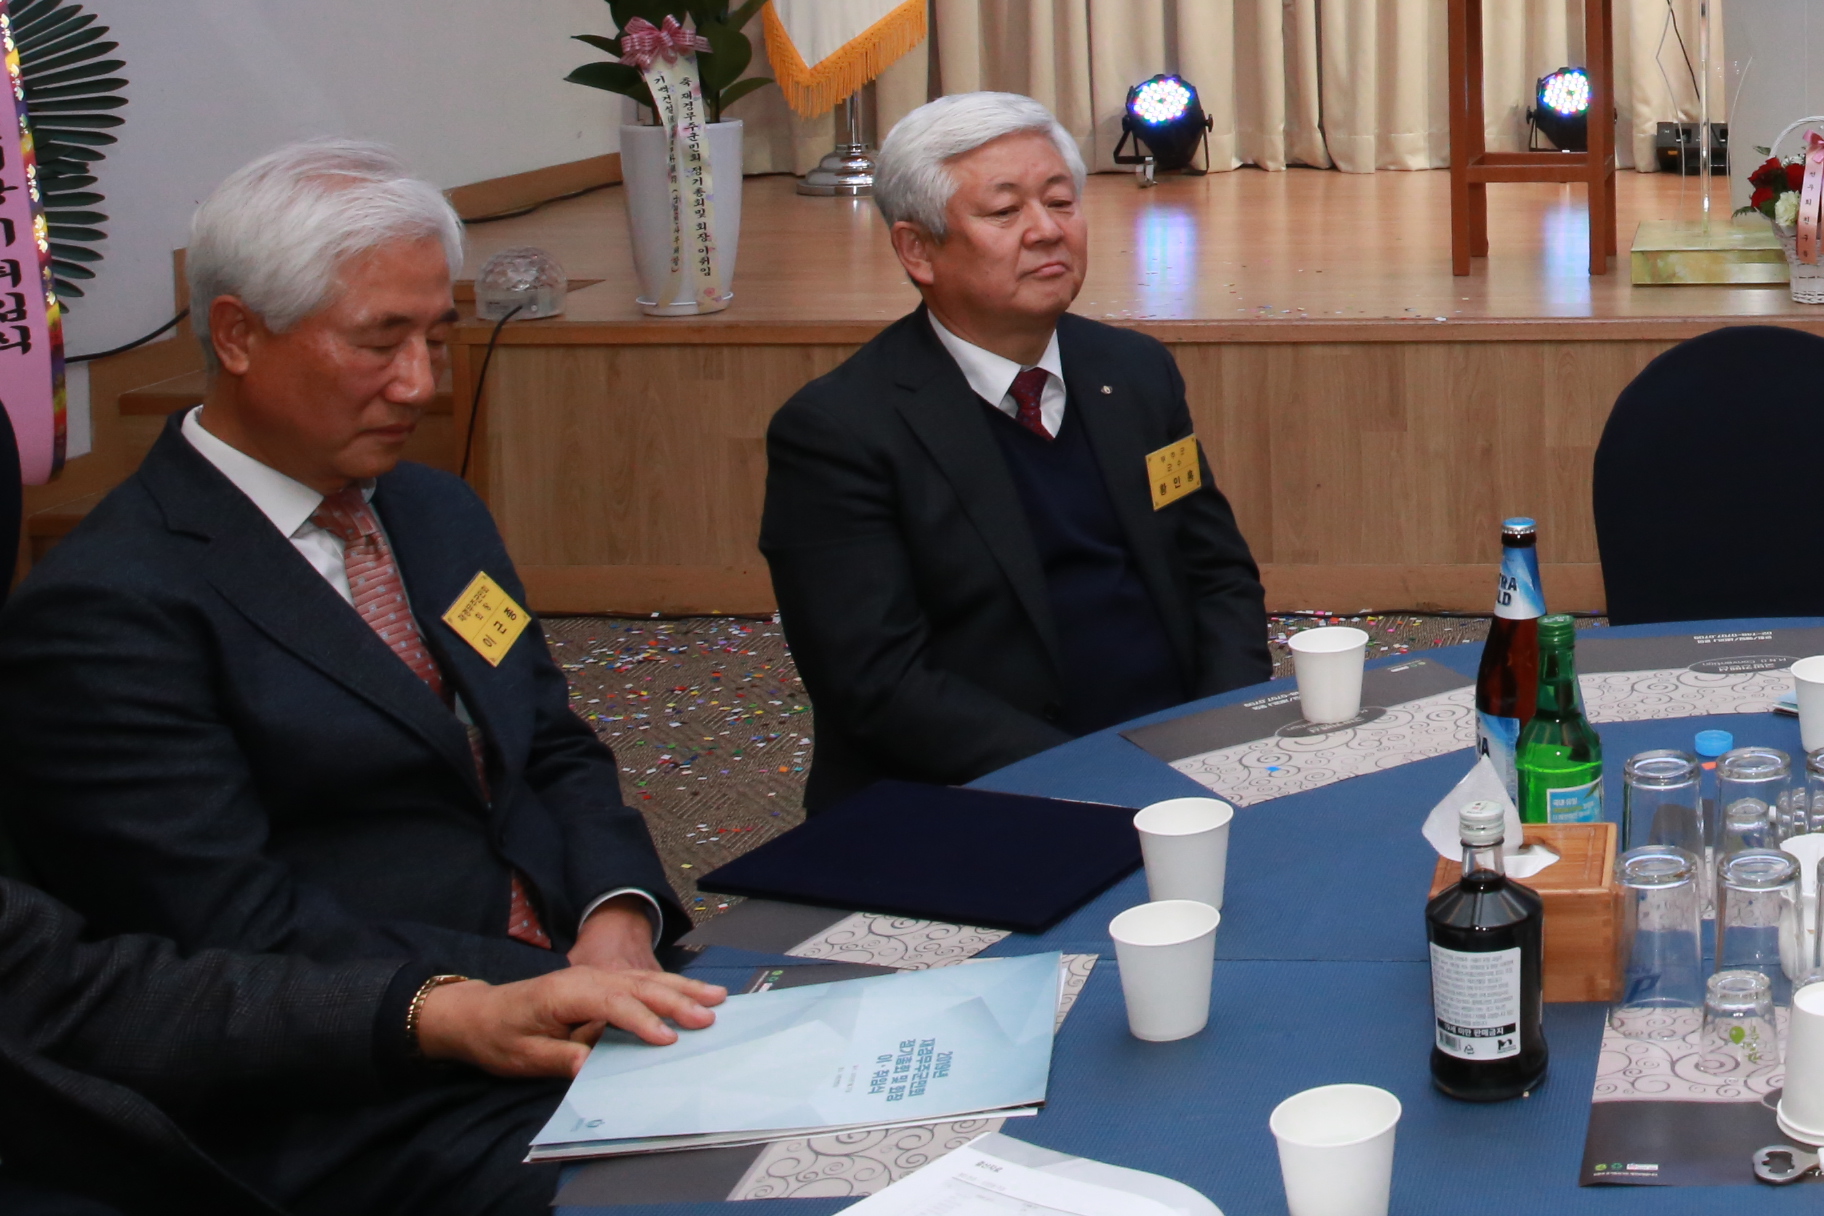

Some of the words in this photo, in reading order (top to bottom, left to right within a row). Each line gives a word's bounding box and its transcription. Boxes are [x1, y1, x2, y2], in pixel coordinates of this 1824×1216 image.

[1497, 592, 1512, 607] LD
[483, 607, 517, 648] 이근종
[1473, 1026, 1504, 1037] 판매금지
[893, 1039, 916, 1073] 정기총회
[932, 1051, 953, 1078] 2019년
[908, 1038, 935, 1097] 재경무주군민회
[891, 1075, 908, 1084] 및
[886, 1085, 906, 1101] 회장
